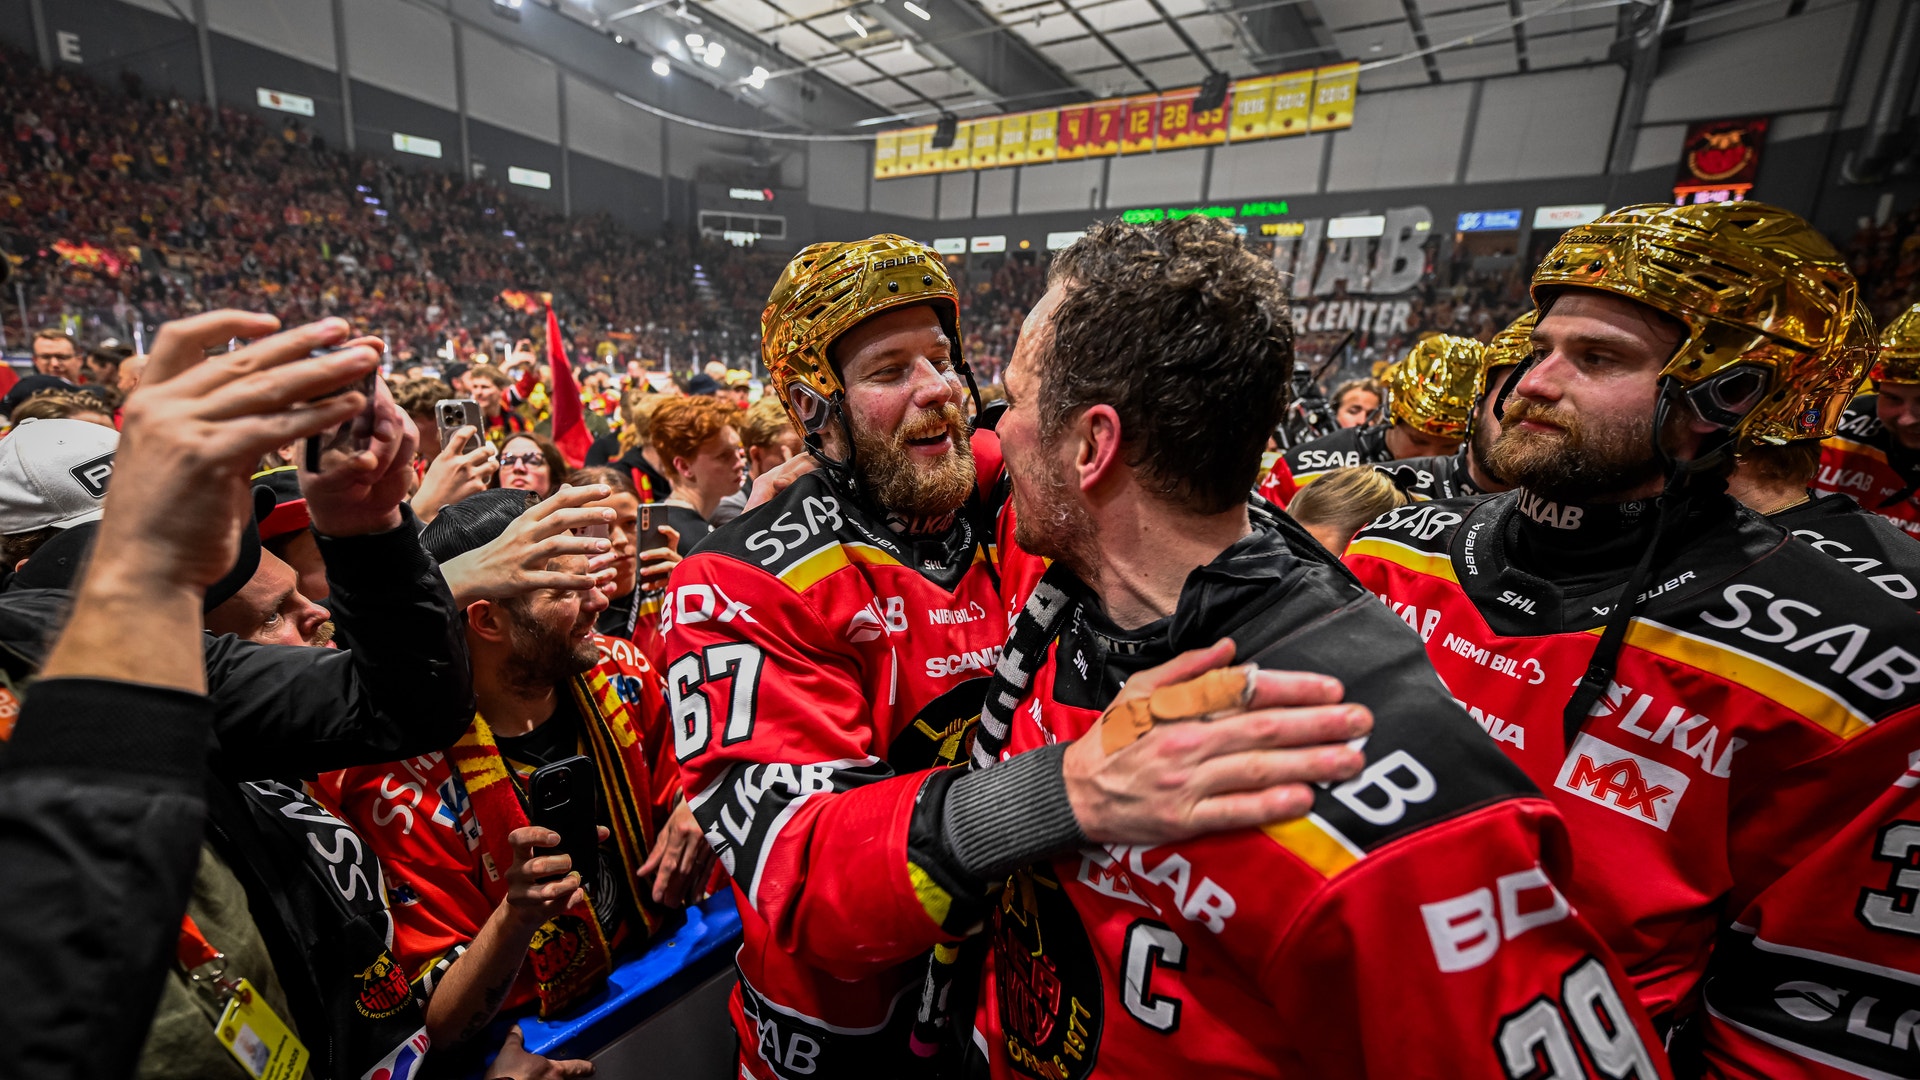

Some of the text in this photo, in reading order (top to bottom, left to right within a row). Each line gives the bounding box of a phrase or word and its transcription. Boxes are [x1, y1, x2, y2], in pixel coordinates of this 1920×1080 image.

[56, 31, 83, 64] E
[1066, 117, 1081, 141] 4
[1098, 113, 1112, 138] 7
[1129, 109, 1150, 134] 12
[1162, 103, 1189, 130] 28
[872, 254, 926, 272] BAUER
[1297, 450, 1360, 470] SSAB
[745, 495, 844, 566] SSAB
[924, 559, 947, 571] SHL
[1464, 530, 1479, 576] BAUER
[1496, 590, 1537, 616] SHL
[1442, 632, 1490, 666] NIEMI
[1699, 583, 1920, 700] SSAB
[1072, 649, 1089, 680] SHL
[667, 640, 766, 766] 67
[1566, 753, 1674, 822] MAX
[720, 762, 835, 847] LKAB
[1418, 866, 1573, 974] BD
[1119, 917, 1189, 1036] C
[1062, 996, 1092, 1061] 1977
